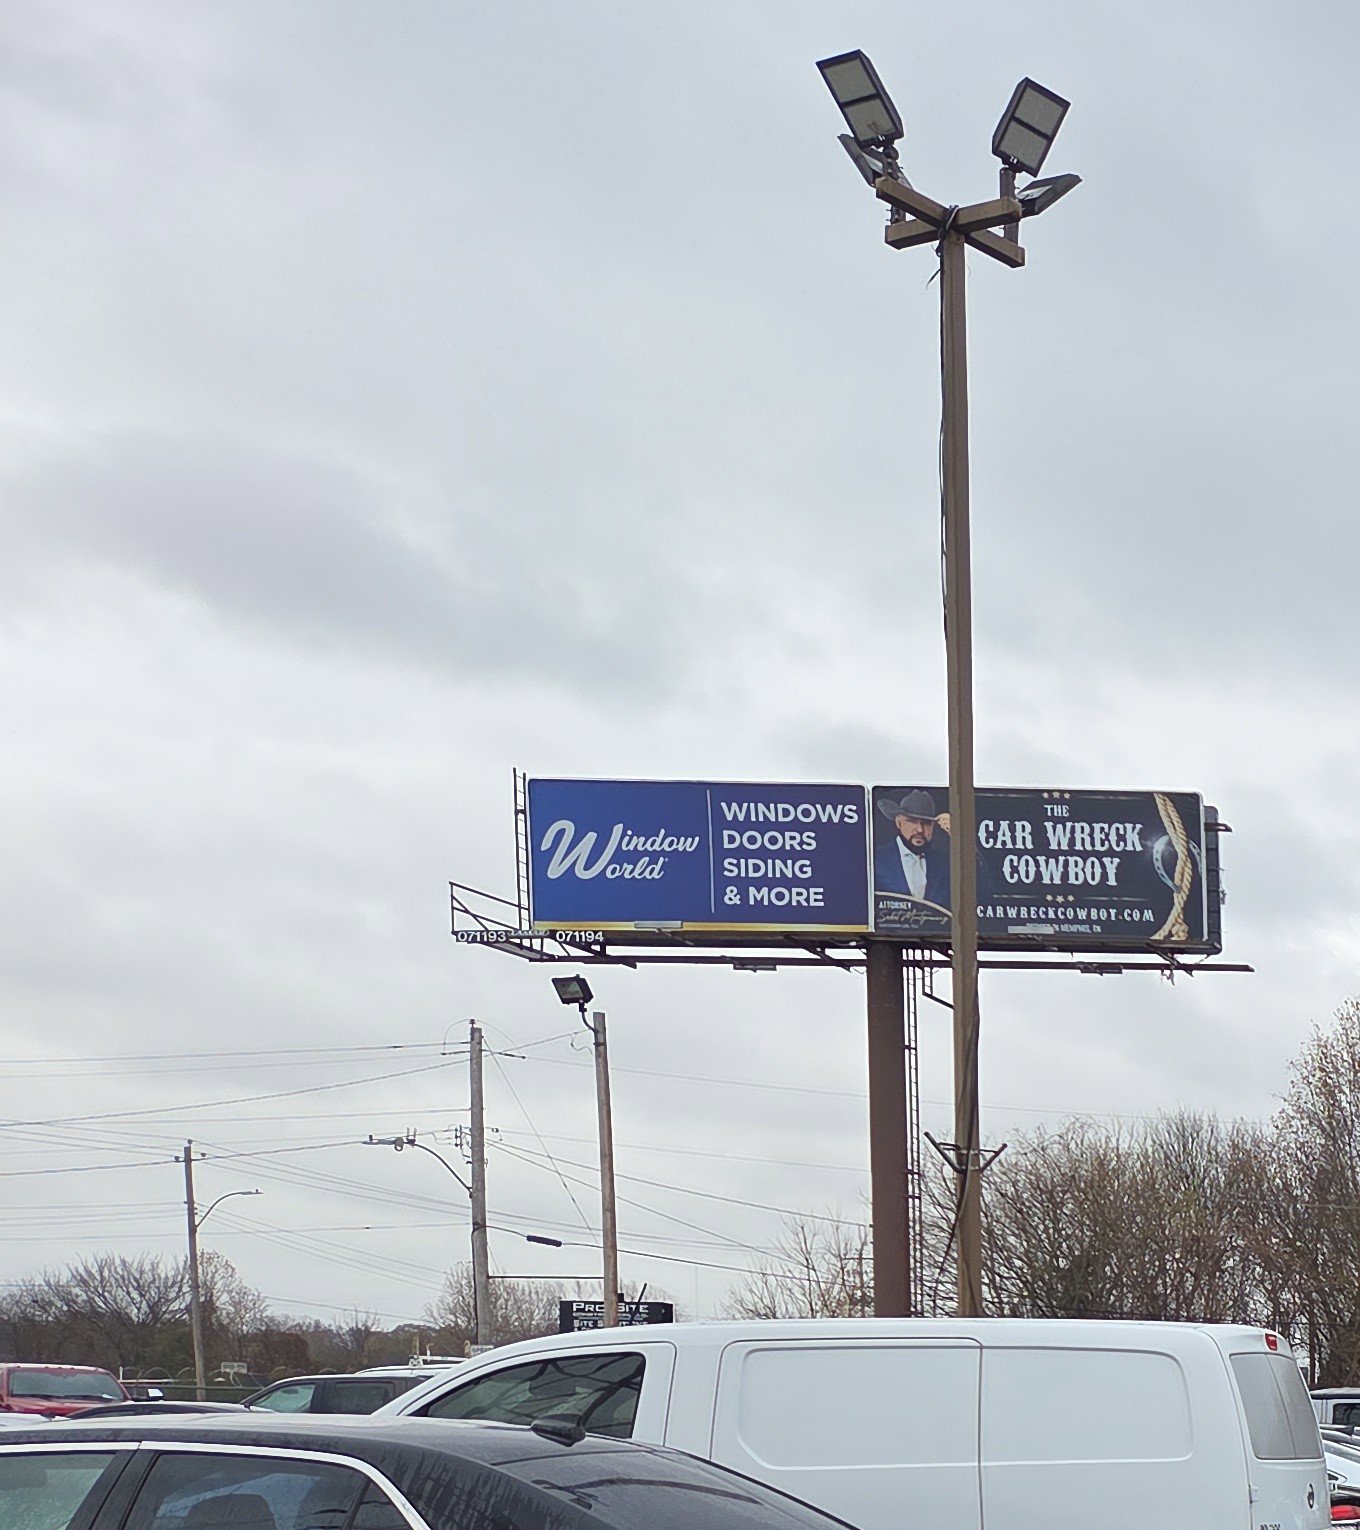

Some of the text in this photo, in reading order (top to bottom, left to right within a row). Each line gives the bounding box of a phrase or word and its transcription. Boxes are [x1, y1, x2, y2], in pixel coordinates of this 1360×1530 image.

[720, 802, 859, 824] WINDOWS
[1043, 804, 1070, 817] THE
[723, 830, 817, 850] DOORS
[977, 819, 1144, 852] CAR WRECK
[723, 858, 812, 879] SIDING
[1002, 854, 1121, 886] COWBOY
[723, 885, 825, 907] & MORE
[976, 905, 1155, 922] CARWRECKCOWBOY.COM
[457, 930, 507, 943] 071193
[555, 930, 604, 943] 071194
